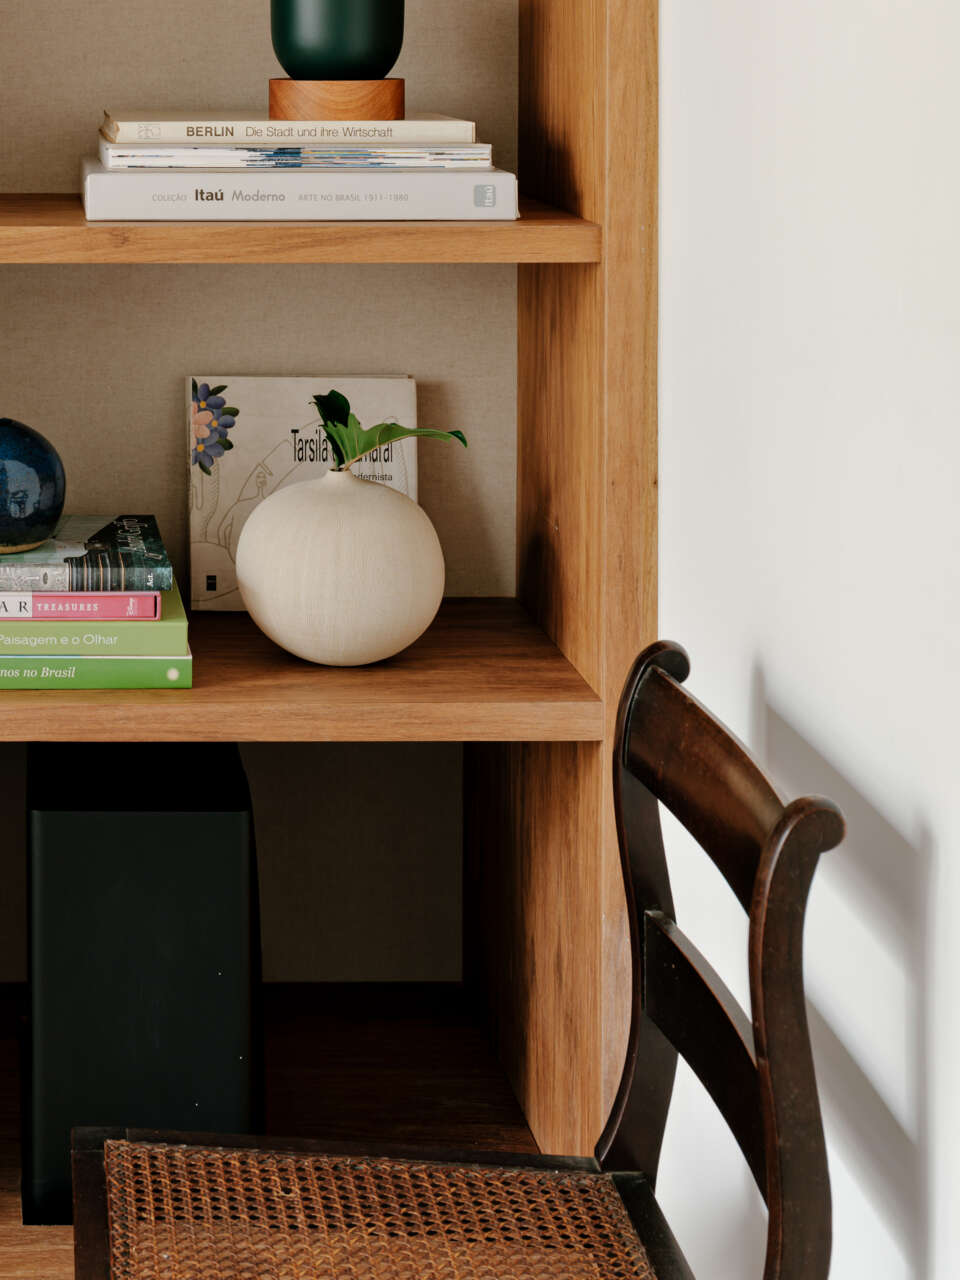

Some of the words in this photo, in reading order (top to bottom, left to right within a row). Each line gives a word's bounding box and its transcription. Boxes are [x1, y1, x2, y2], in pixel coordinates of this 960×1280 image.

[186, 126, 234, 137] BERLIN
[245, 126, 263, 137] Die
[266, 126, 295, 137] Stadt
[297, 126, 317, 137] und
[320, 126, 339, 137] ihre
[342, 126, 393, 137] Wirtschaft
[195, 188, 224, 202] Itaú
[231, 190, 286, 202] Moderno
[298, 193, 318, 202] ARTE
[321, 193, 336, 202] NO
[339, 193, 361, 202] BRASIL
[291, 429, 328, 463] Tarsila
[37, 603, 99, 611] TREASURES
[59, 636, 70, 645] e
[71, 636, 81, 645] o
[82, 633, 119, 645] Olhar
[23, 668, 38, 677] no
[40, 666, 76, 679] Brasil
